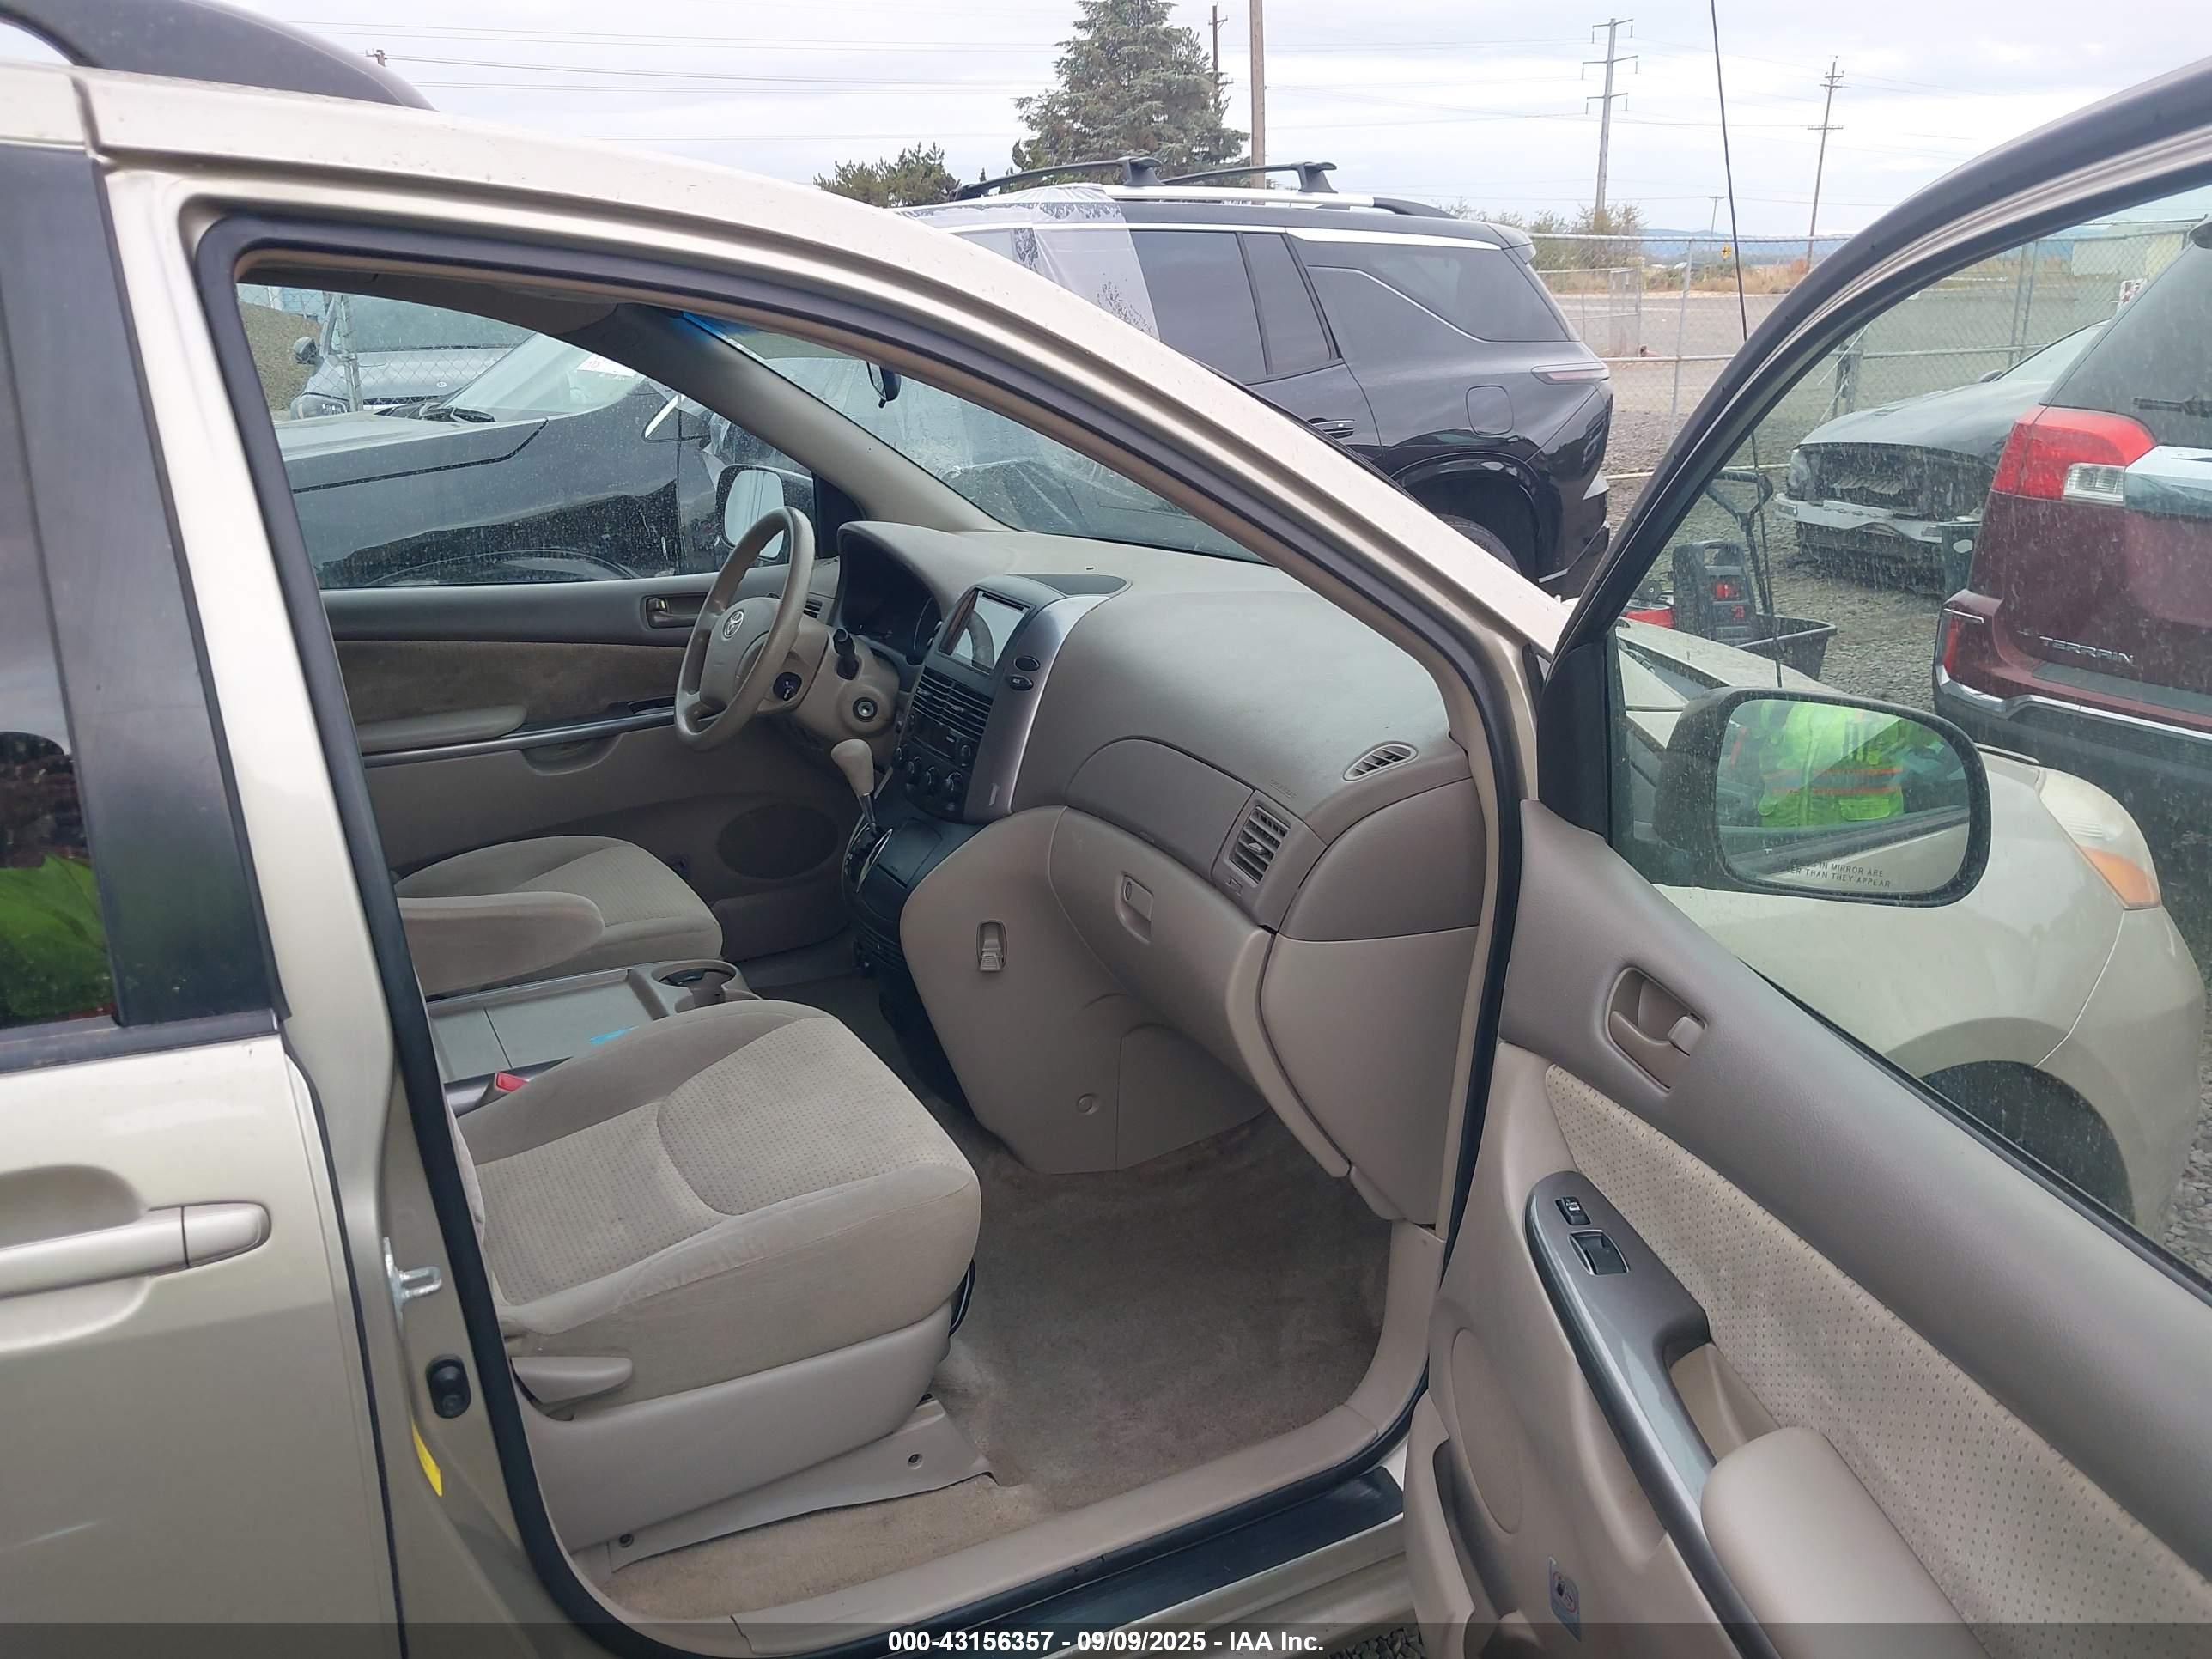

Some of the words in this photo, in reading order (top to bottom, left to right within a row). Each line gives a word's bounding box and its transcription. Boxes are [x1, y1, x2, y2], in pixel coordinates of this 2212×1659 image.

[2039, 635, 2134, 665] TERRAIN
[1806, 868, 1828, 878] THAN
[1832, 872, 1853, 883] THEY
[1856, 876, 1891, 888] APPEAR
[1831, 863, 1864, 875] MIRROR
[1867, 869, 1883, 878] ARE
